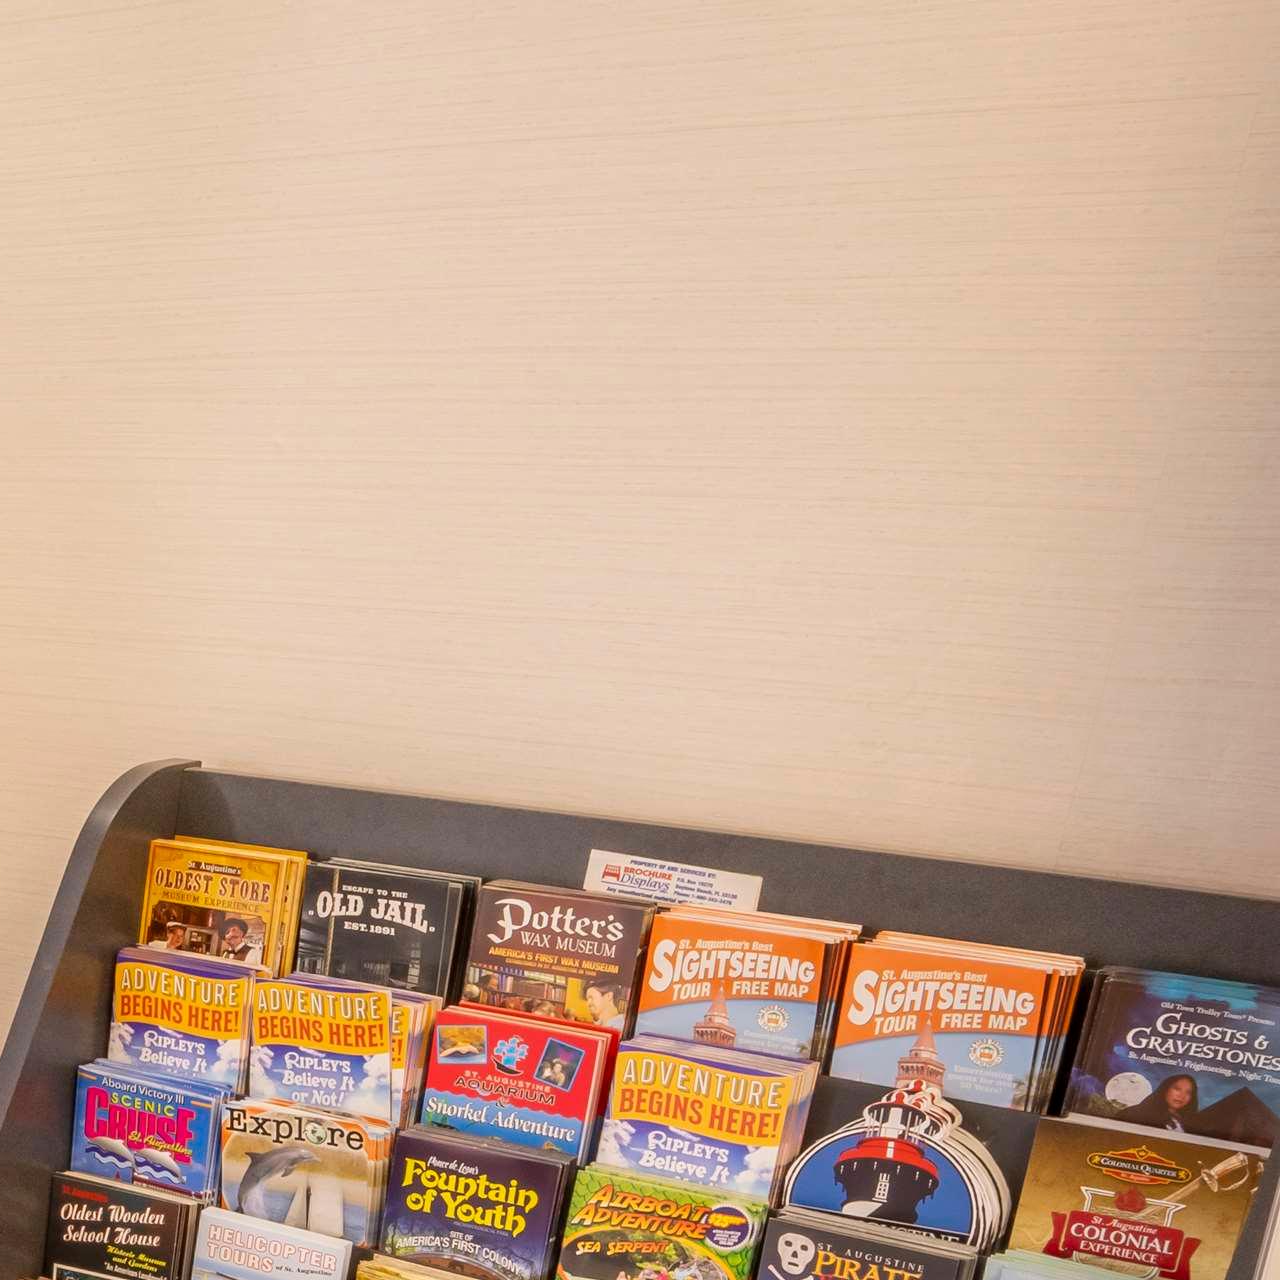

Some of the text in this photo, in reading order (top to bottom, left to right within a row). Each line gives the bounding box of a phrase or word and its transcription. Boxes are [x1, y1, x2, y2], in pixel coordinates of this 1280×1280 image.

[155, 869, 270, 903] OLDEST STORE
[317, 891, 428, 933] OLD JAIL
[487, 898, 624, 944] Potter's
[344, 922, 395, 935] EST. 1891
[489, 947, 559, 963] AMERICA'S FIRST
[520, 931, 616, 958] WAX MUSEUM
[752, 942, 773, 951] Best
[648, 939, 816, 992] SIGHTSEEING
[964, 972, 987, 982] Best
[122, 969, 238, 1006] ADVENTURE
[672, 981, 809, 1001] TOUR FREE MAP
[847, 970, 1035, 1026] SIGHTSEEING
[121, 995, 239, 1033] BEGINS HERE!
[258, 990, 380, 1020] ADVENTURE
[258, 1017, 384, 1047] BEGINS HERE!
[875, 1014, 1028, 1035] TOUR FREE MAP
[1156, 1013, 1248, 1044] GHOSTS
[111, 1093, 175, 1116] SCENIC
[456, 1076, 555, 1105] AQUARIUM
[84, 1087, 198, 1164] CRUISE
[426, 1097, 575, 1141] Snorkel Adventure
[402, 1157, 539, 1213] Fountain
[61, 1203, 165, 1225] Oldest Wooden
[406, 1189, 526, 1238] of Youth
[589, 1184, 714, 1222] AIRBOAT
[63, 1226, 160, 1247] School House
[208, 1224, 337, 1271] HELICOPTER
[396, 1237, 480, 1254] AMERICA'S FIRST
[607, 1240, 671, 1255] SERPENT
[1070, 1223, 1173, 1254] COLONIAL
[208, 1242, 273, 1272] TOURS
